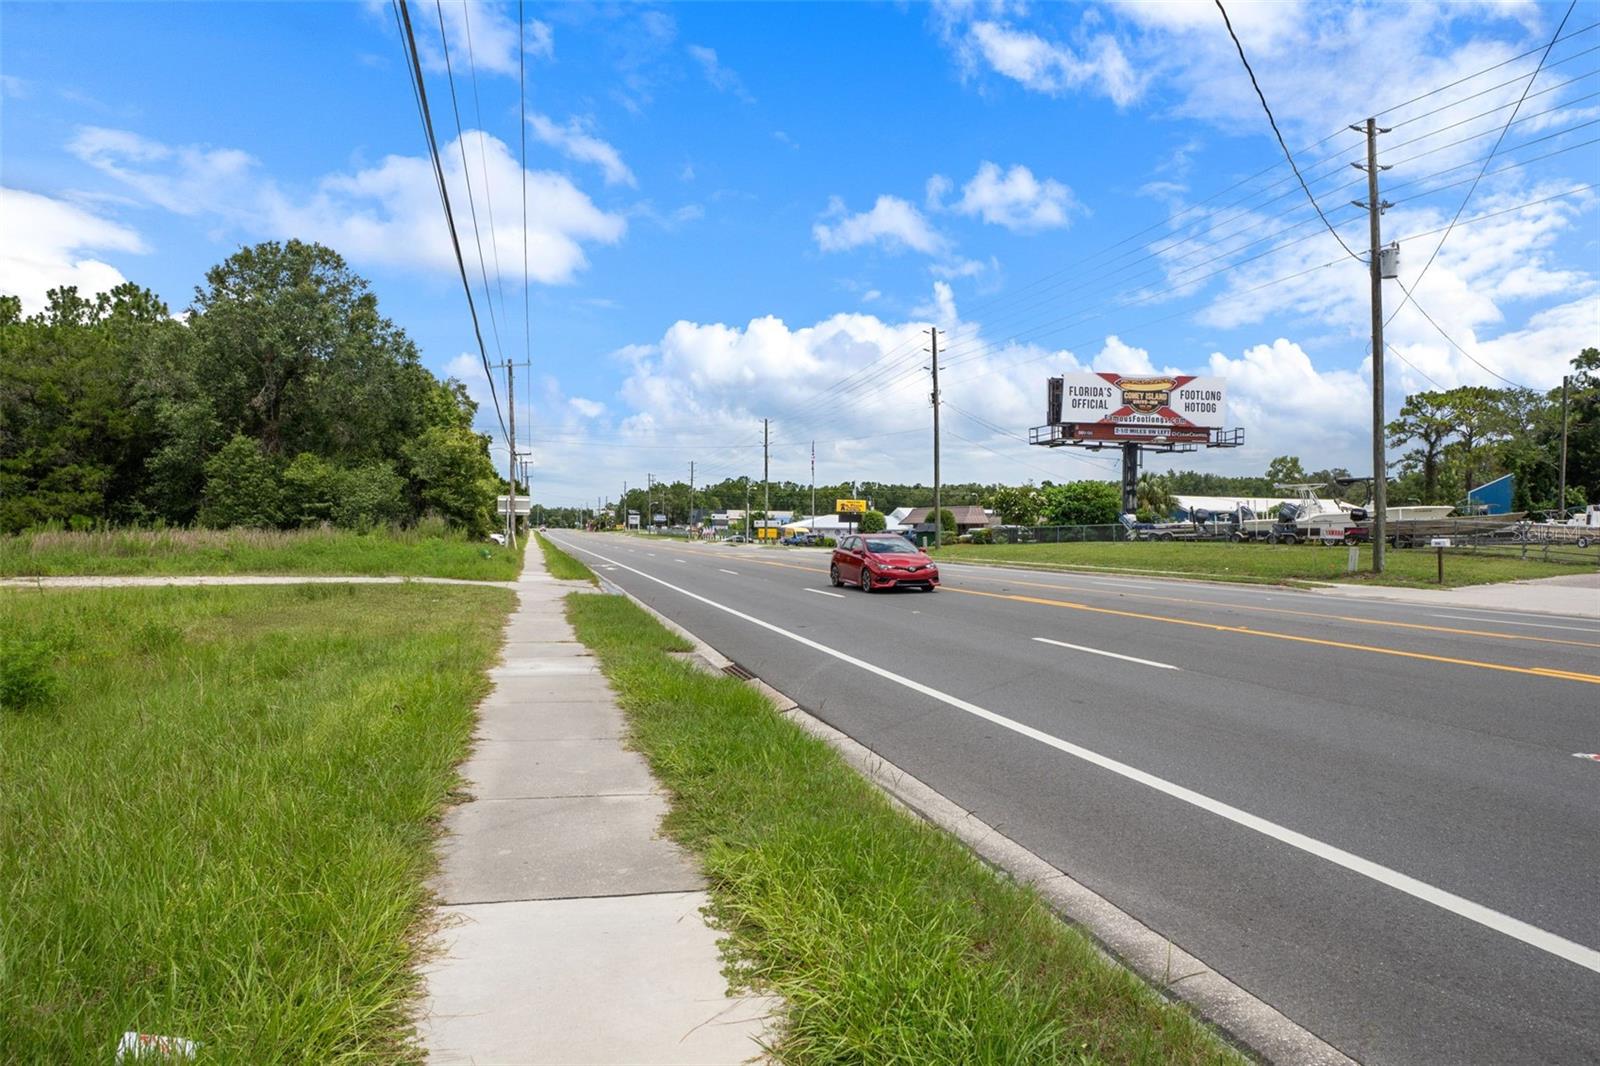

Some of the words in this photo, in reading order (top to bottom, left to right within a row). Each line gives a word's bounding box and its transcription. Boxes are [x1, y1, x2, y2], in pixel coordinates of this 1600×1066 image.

[1069, 386, 1112, 397] FLORIDA'S
[1180, 390, 1221, 401] FOOTLONG
[1072, 398, 1108, 409] OFFICIAL
[1184, 402, 1216, 413] HOTDOG
